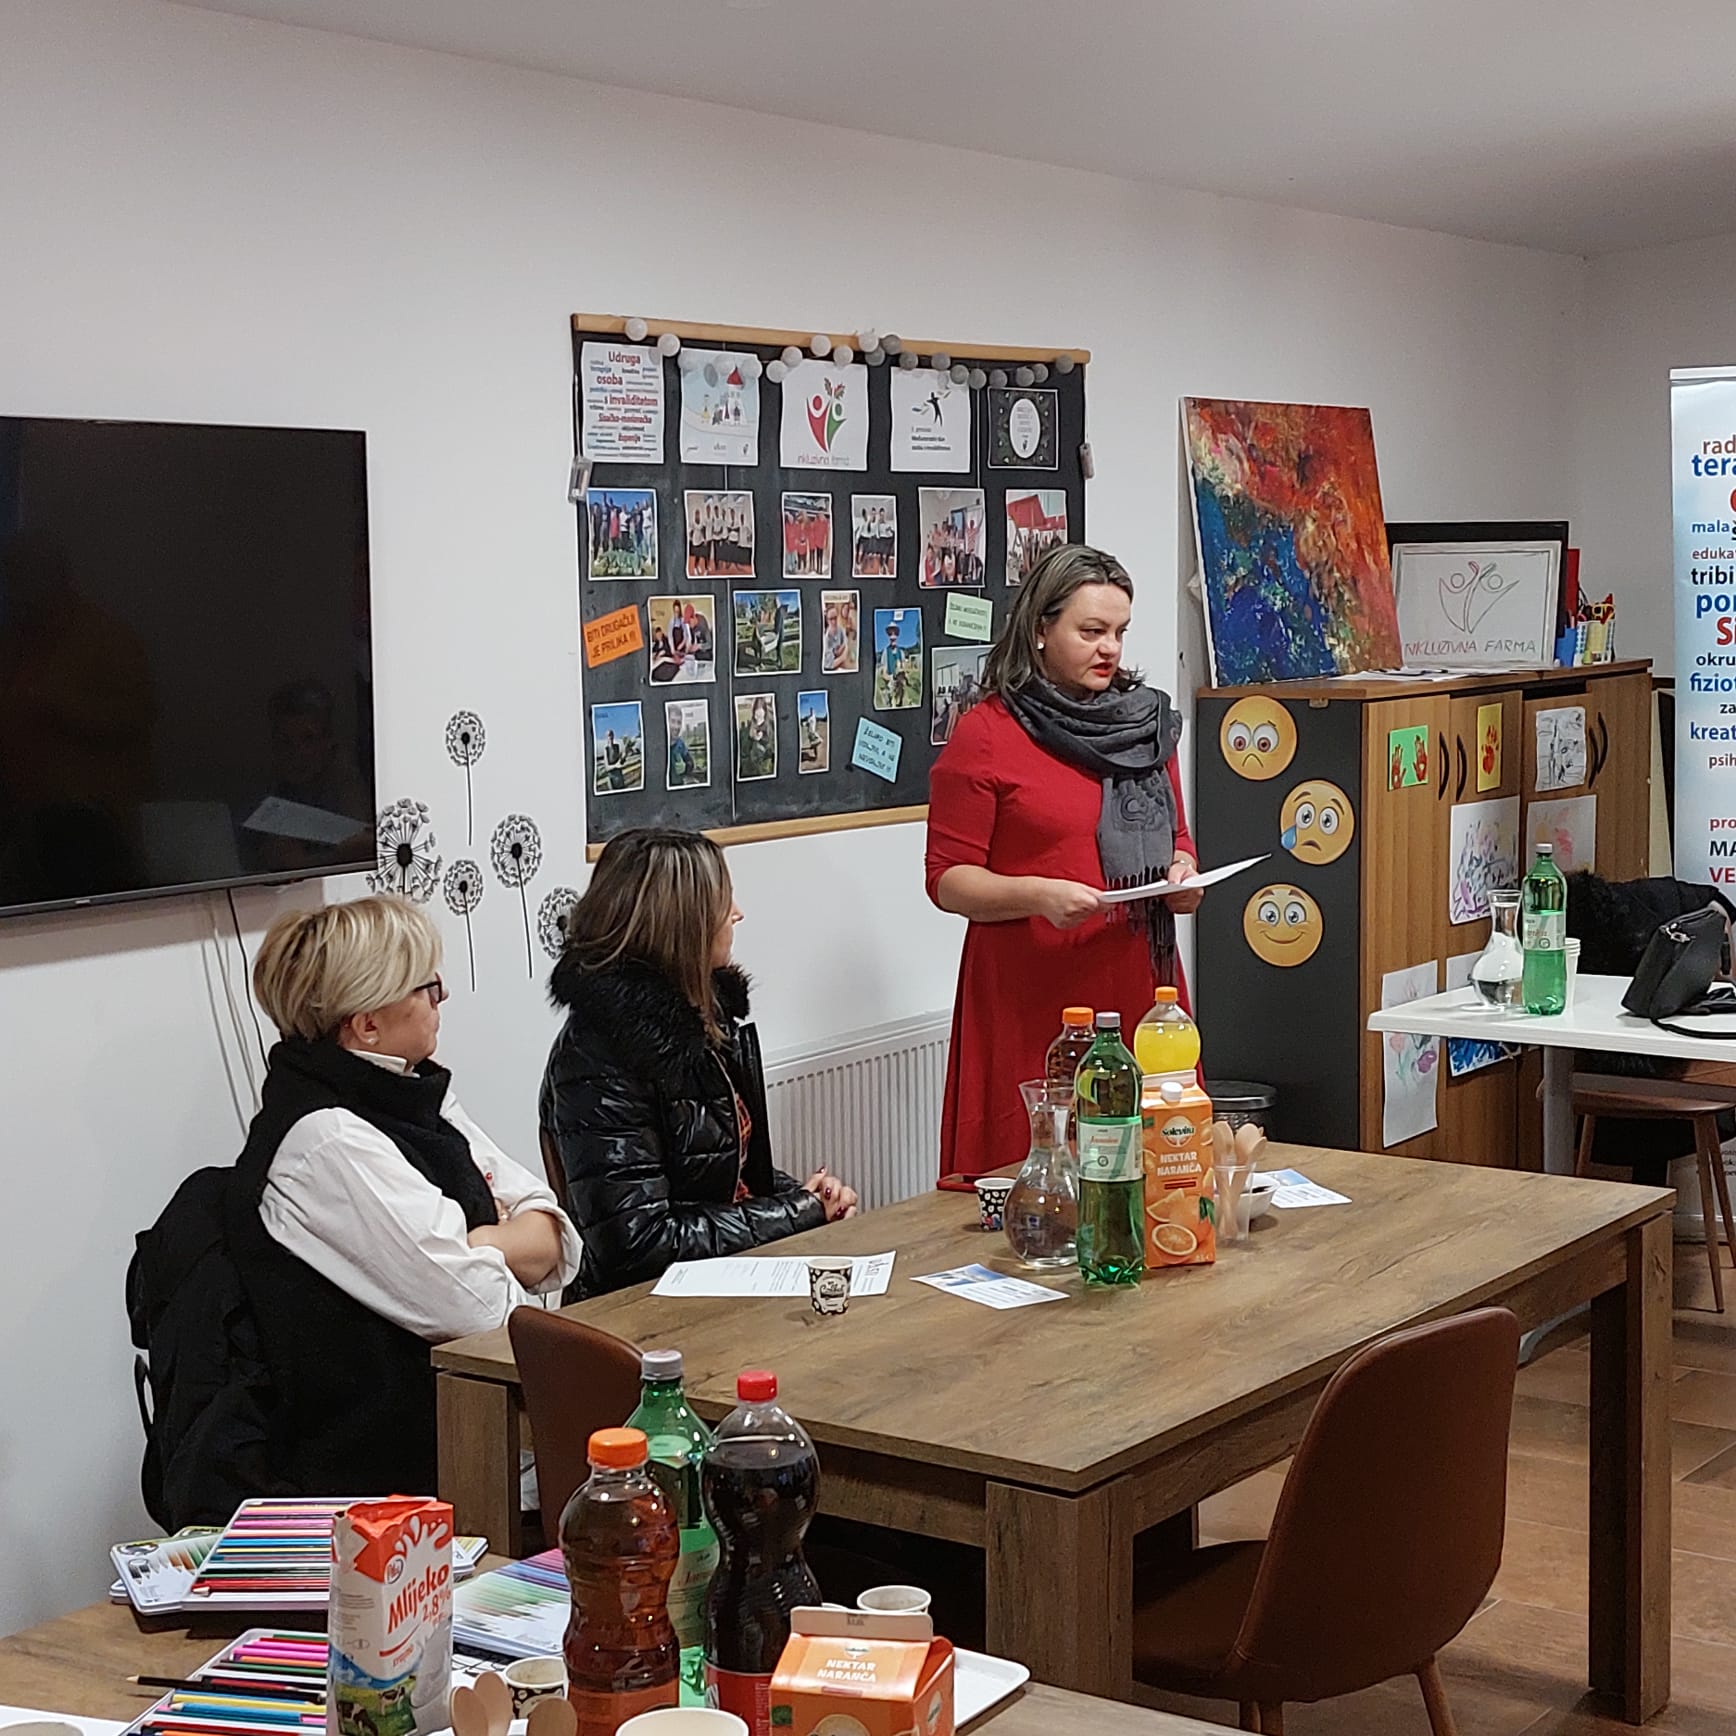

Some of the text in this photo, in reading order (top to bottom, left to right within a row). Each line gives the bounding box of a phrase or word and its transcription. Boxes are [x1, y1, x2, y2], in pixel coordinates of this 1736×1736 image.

[608, 351, 641, 367] Udruga
[596, 373, 623, 385] osoba
[1692, 519, 1730, 533] mala
[1692, 546, 1736, 560] eduka
[1691, 565, 1734, 585] tribi
[1696, 594, 1736, 619] po
[1717, 616, 1736, 645] S
[1405, 639, 1536, 656] NKLUZIVNA FARMA
[1690, 672, 1736, 692] fizio
[1160, 1151, 1197, 1163] NEKTAR
[1157, 1163, 1202, 1177] NARANČA
[388, 1564, 449, 1634] Mlijeko
[826, 1659, 876, 1671] NEKTAR
[817, 1668, 877, 1683] NARANČA
